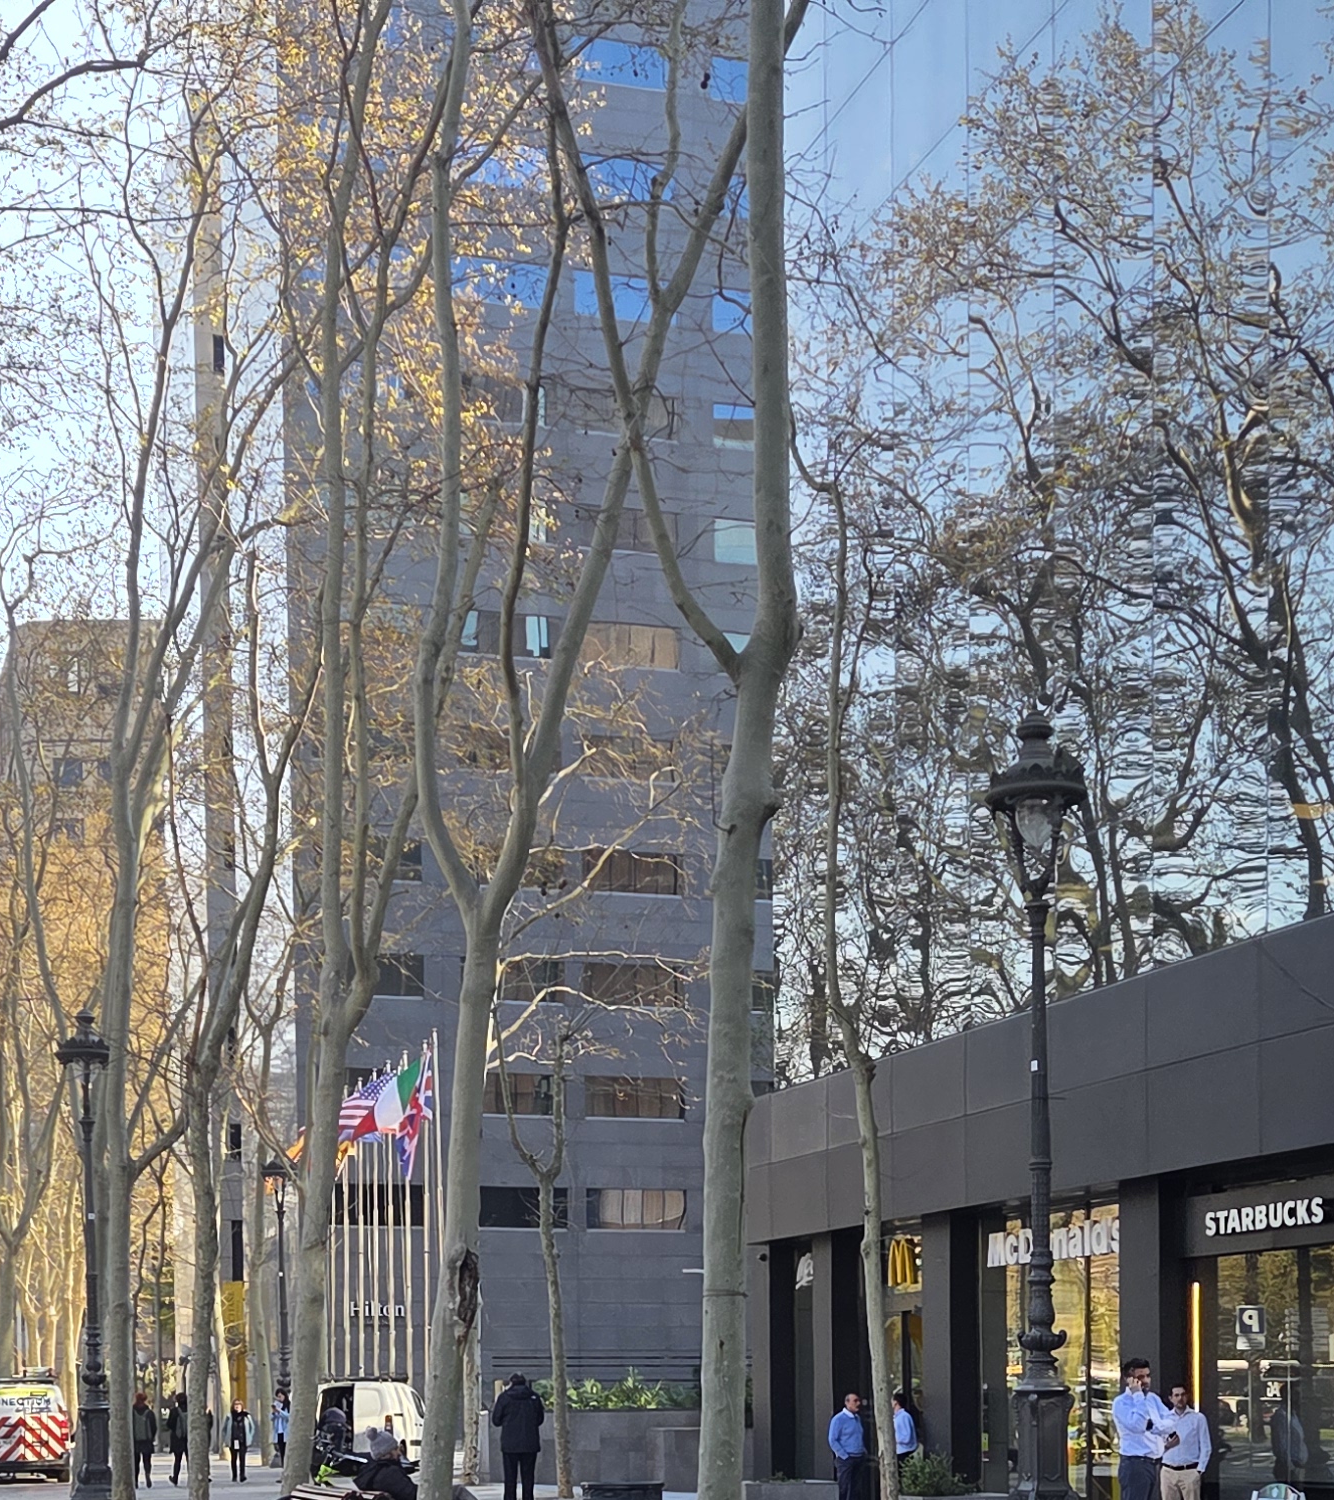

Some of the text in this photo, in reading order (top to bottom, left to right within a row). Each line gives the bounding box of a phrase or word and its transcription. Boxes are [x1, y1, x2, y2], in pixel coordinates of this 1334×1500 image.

[1204, 1196, 1324, 1237] STARBUCKS
[986, 1219, 1120, 1268] McDnald's
[350, 1301, 406, 1317] Hilton
